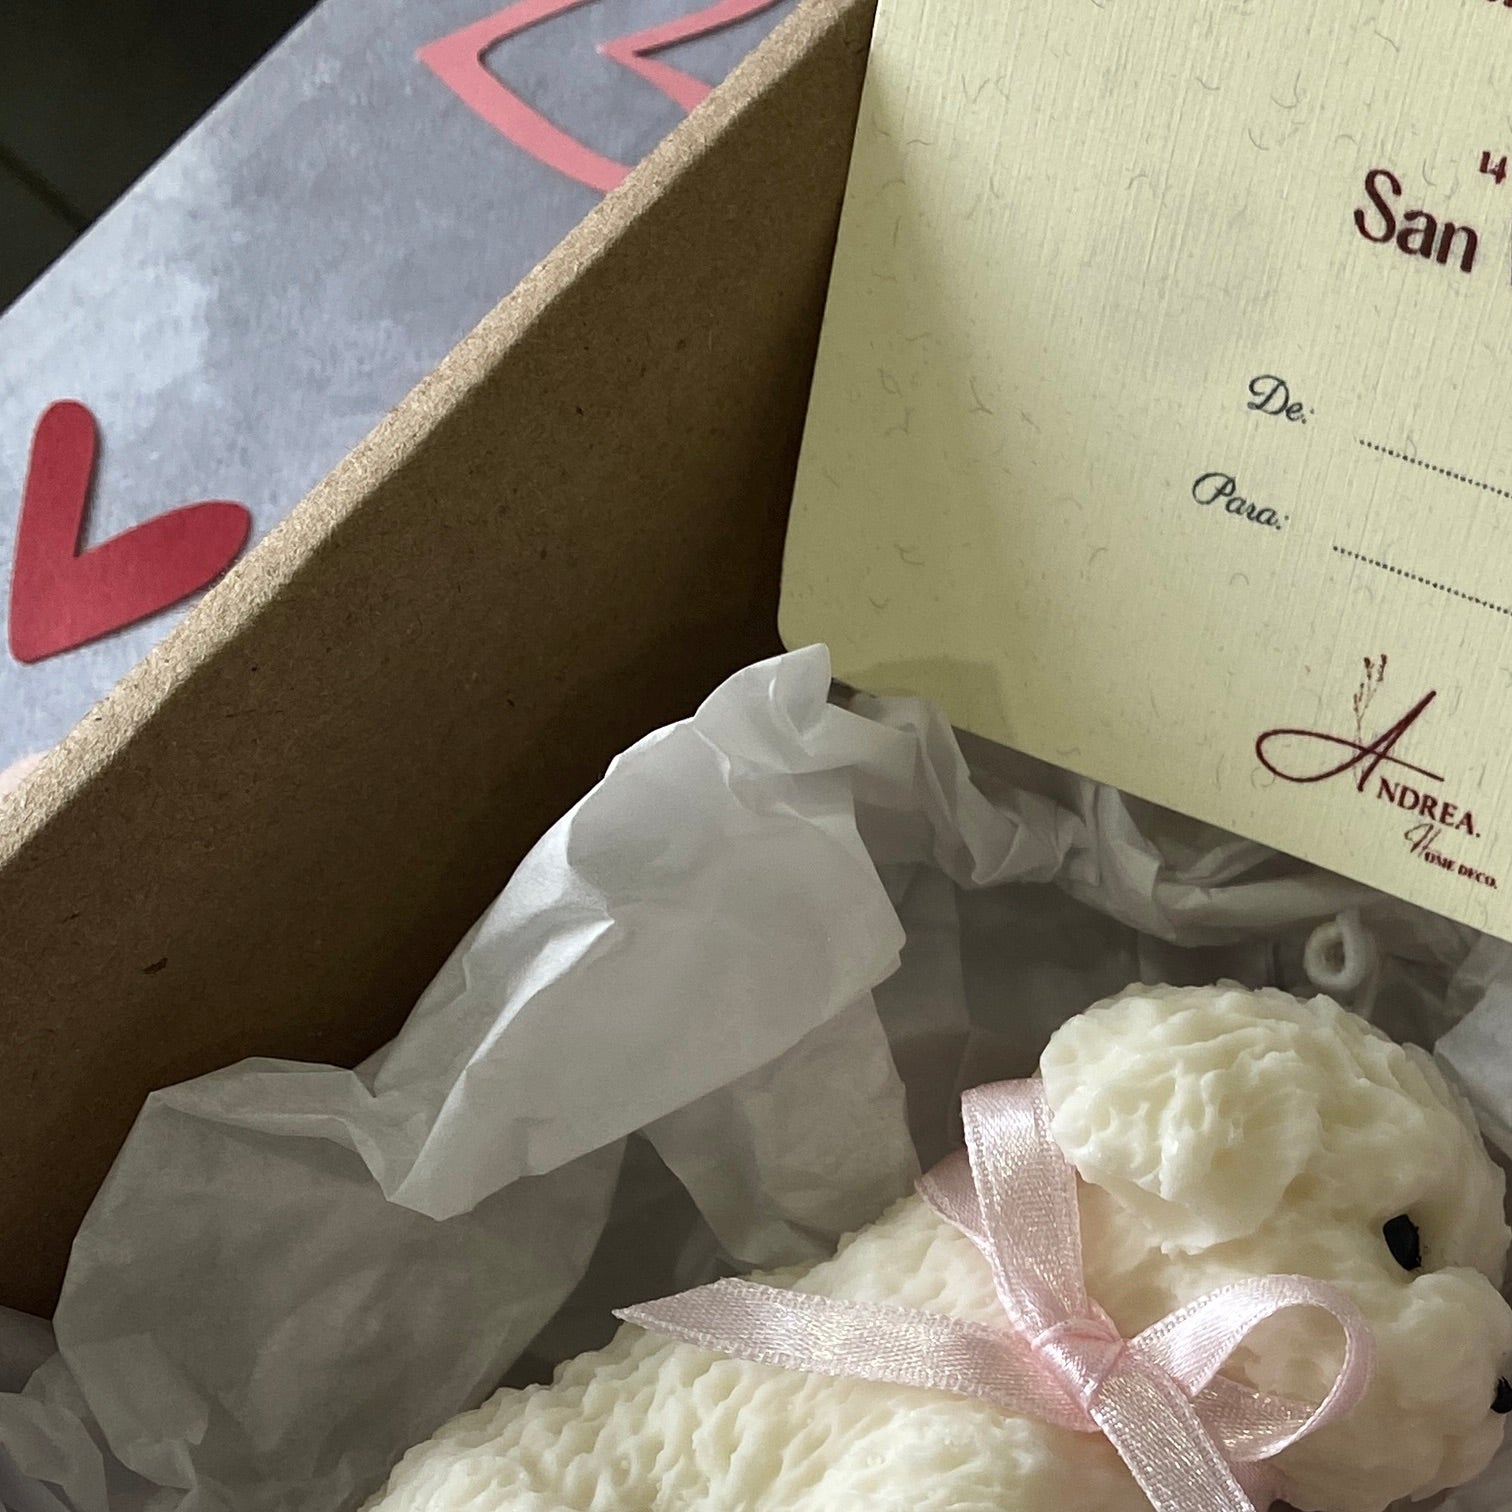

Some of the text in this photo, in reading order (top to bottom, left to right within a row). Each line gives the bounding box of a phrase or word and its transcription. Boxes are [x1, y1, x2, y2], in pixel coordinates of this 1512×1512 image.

[1478, 150, 1508, 185] 14
[1353, 168, 1479, 275] San
[1246, 373, 1316, 425] De:
[1191, 471, 1290, 531] Para:
